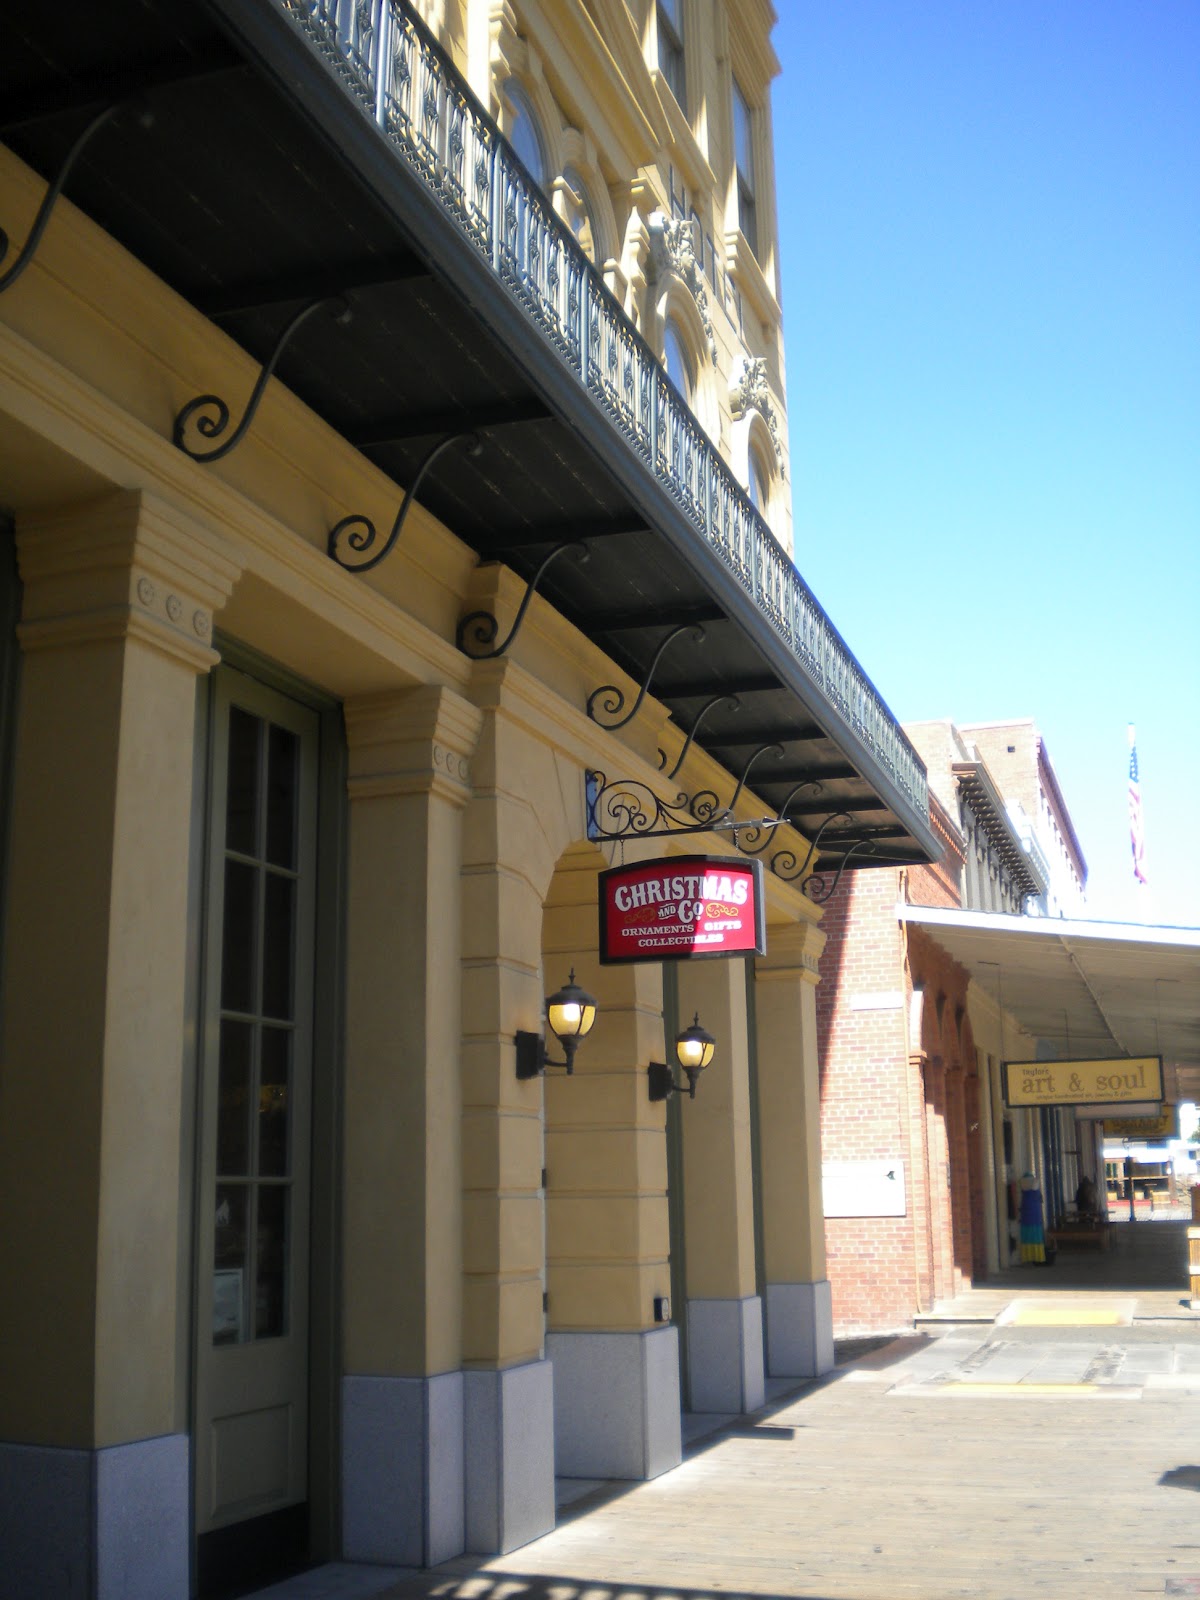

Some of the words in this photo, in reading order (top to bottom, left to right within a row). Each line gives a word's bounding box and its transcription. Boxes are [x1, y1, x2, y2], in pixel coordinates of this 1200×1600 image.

[614, 875, 748, 912] CHRISTMAS
[657, 903, 677, 920] AND
[621, 924, 694, 937] ORNAMENTS
[704, 920, 742, 932] GIFTS
[638, 933, 724, 947] COLLECTIBLES
[1022, 1074, 1056, 1094] art
[1068, 1072, 1085, 1092] &
[1096, 1065, 1146, 1091] soul
